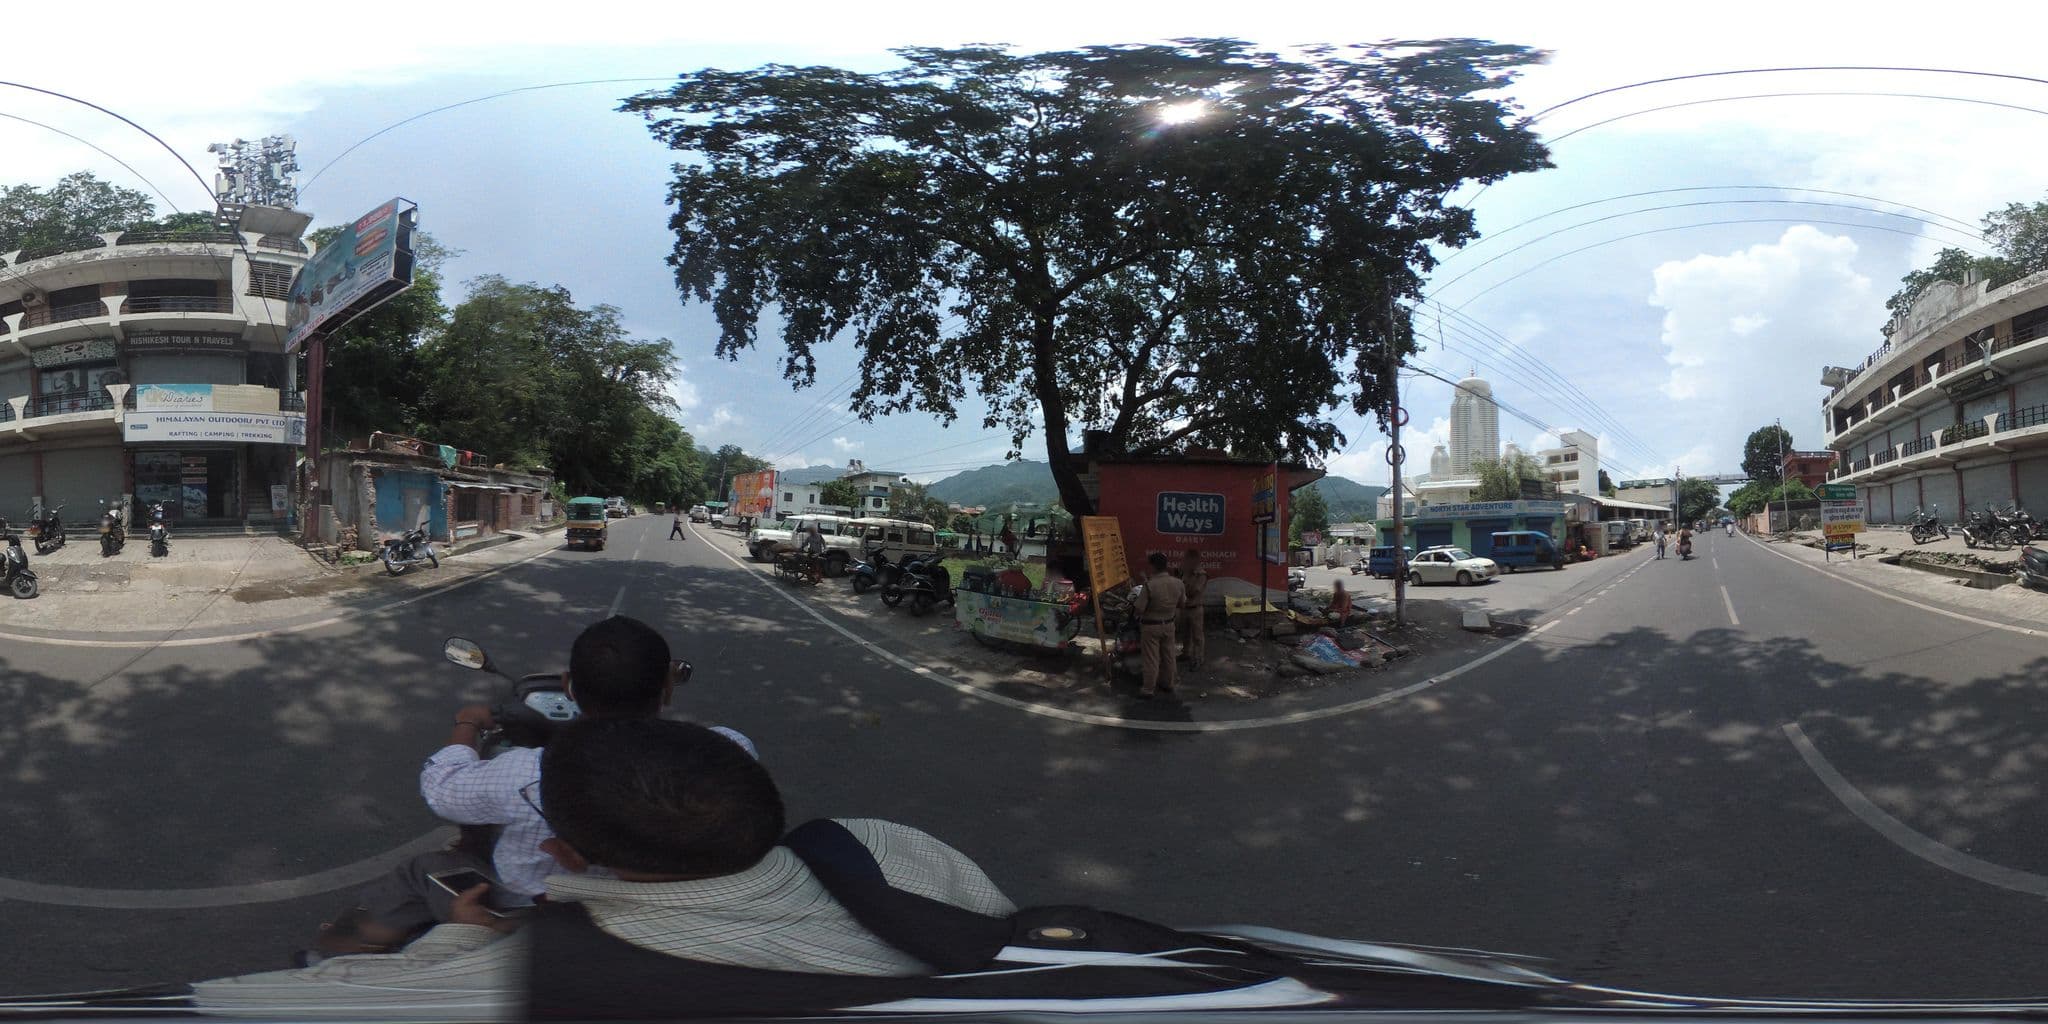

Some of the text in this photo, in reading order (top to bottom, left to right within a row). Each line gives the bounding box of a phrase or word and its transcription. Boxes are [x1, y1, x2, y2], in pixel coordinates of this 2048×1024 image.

[172, 335, 191, 344] TOUR
[203, 336, 234, 346] TRAVELS
[156, 416, 205, 424] HIMALAYAN
[255, 418, 269, 426] PVT
[272, 418, 286, 427] LTD
[1163, 496, 1219, 512] Health
[1452, 504, 1469, 512] STAR
[1470, 502, 1513, 511] ADVENTURE
[1167, 513, 1214, 532] Ways
[1175, 535, 1206, 543] DAIRY
